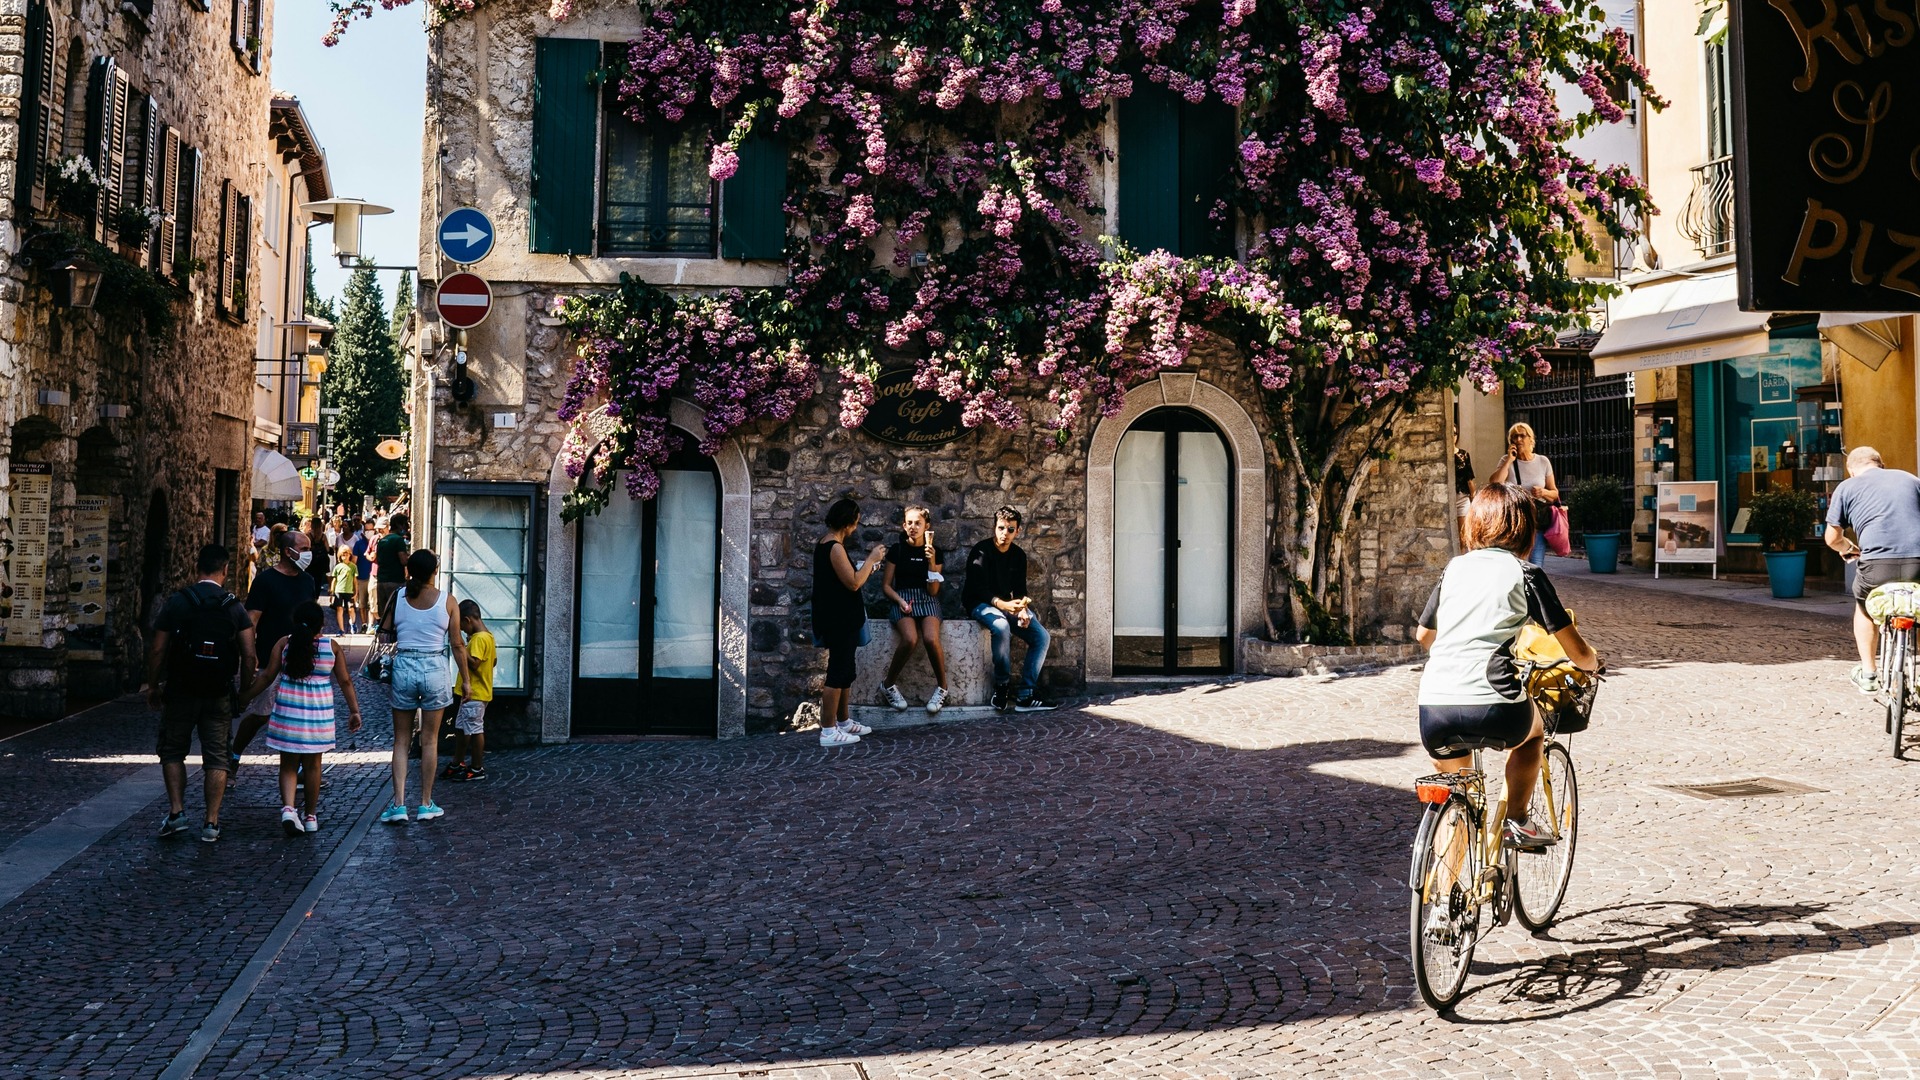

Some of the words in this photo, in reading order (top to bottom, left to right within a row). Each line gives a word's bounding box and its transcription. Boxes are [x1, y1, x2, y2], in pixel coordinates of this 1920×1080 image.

[1674, 349, 1697, 361] GARDA
[1762, 378, 1788, 387] GARDA
[873, 380, 918, 401] Boug
[898, 425, 958, 442] Mancini
